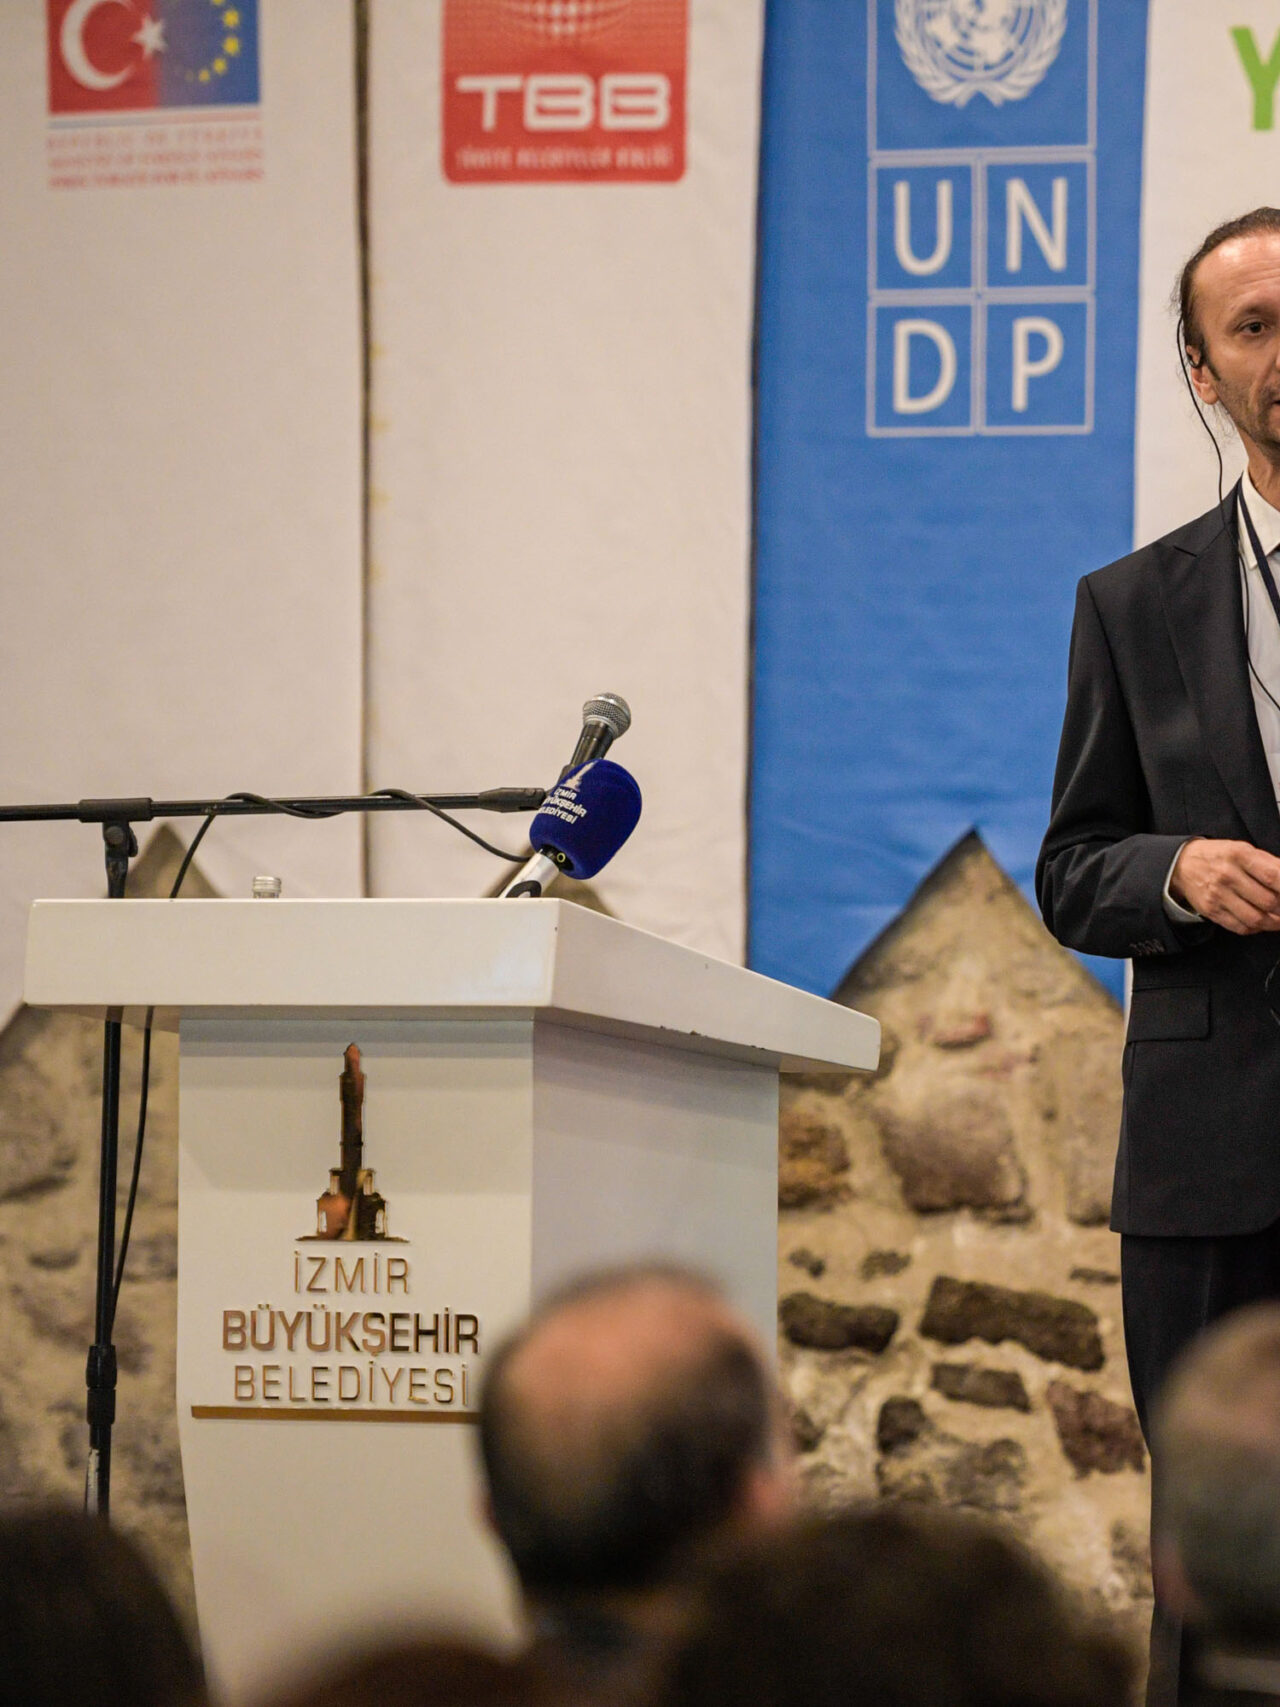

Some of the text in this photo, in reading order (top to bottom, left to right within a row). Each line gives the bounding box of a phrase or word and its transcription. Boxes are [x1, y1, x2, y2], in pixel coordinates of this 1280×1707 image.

[456, 73, 671, 131] TBB
[554, 787, 578, 800] İZMİR
[293, 1250, 409, 1294] İZMİR
[222, 1303, 479, 1357] BÜYÜKŞEHİR
[234, 1360, 469, 1405] BELEDİYESİ
